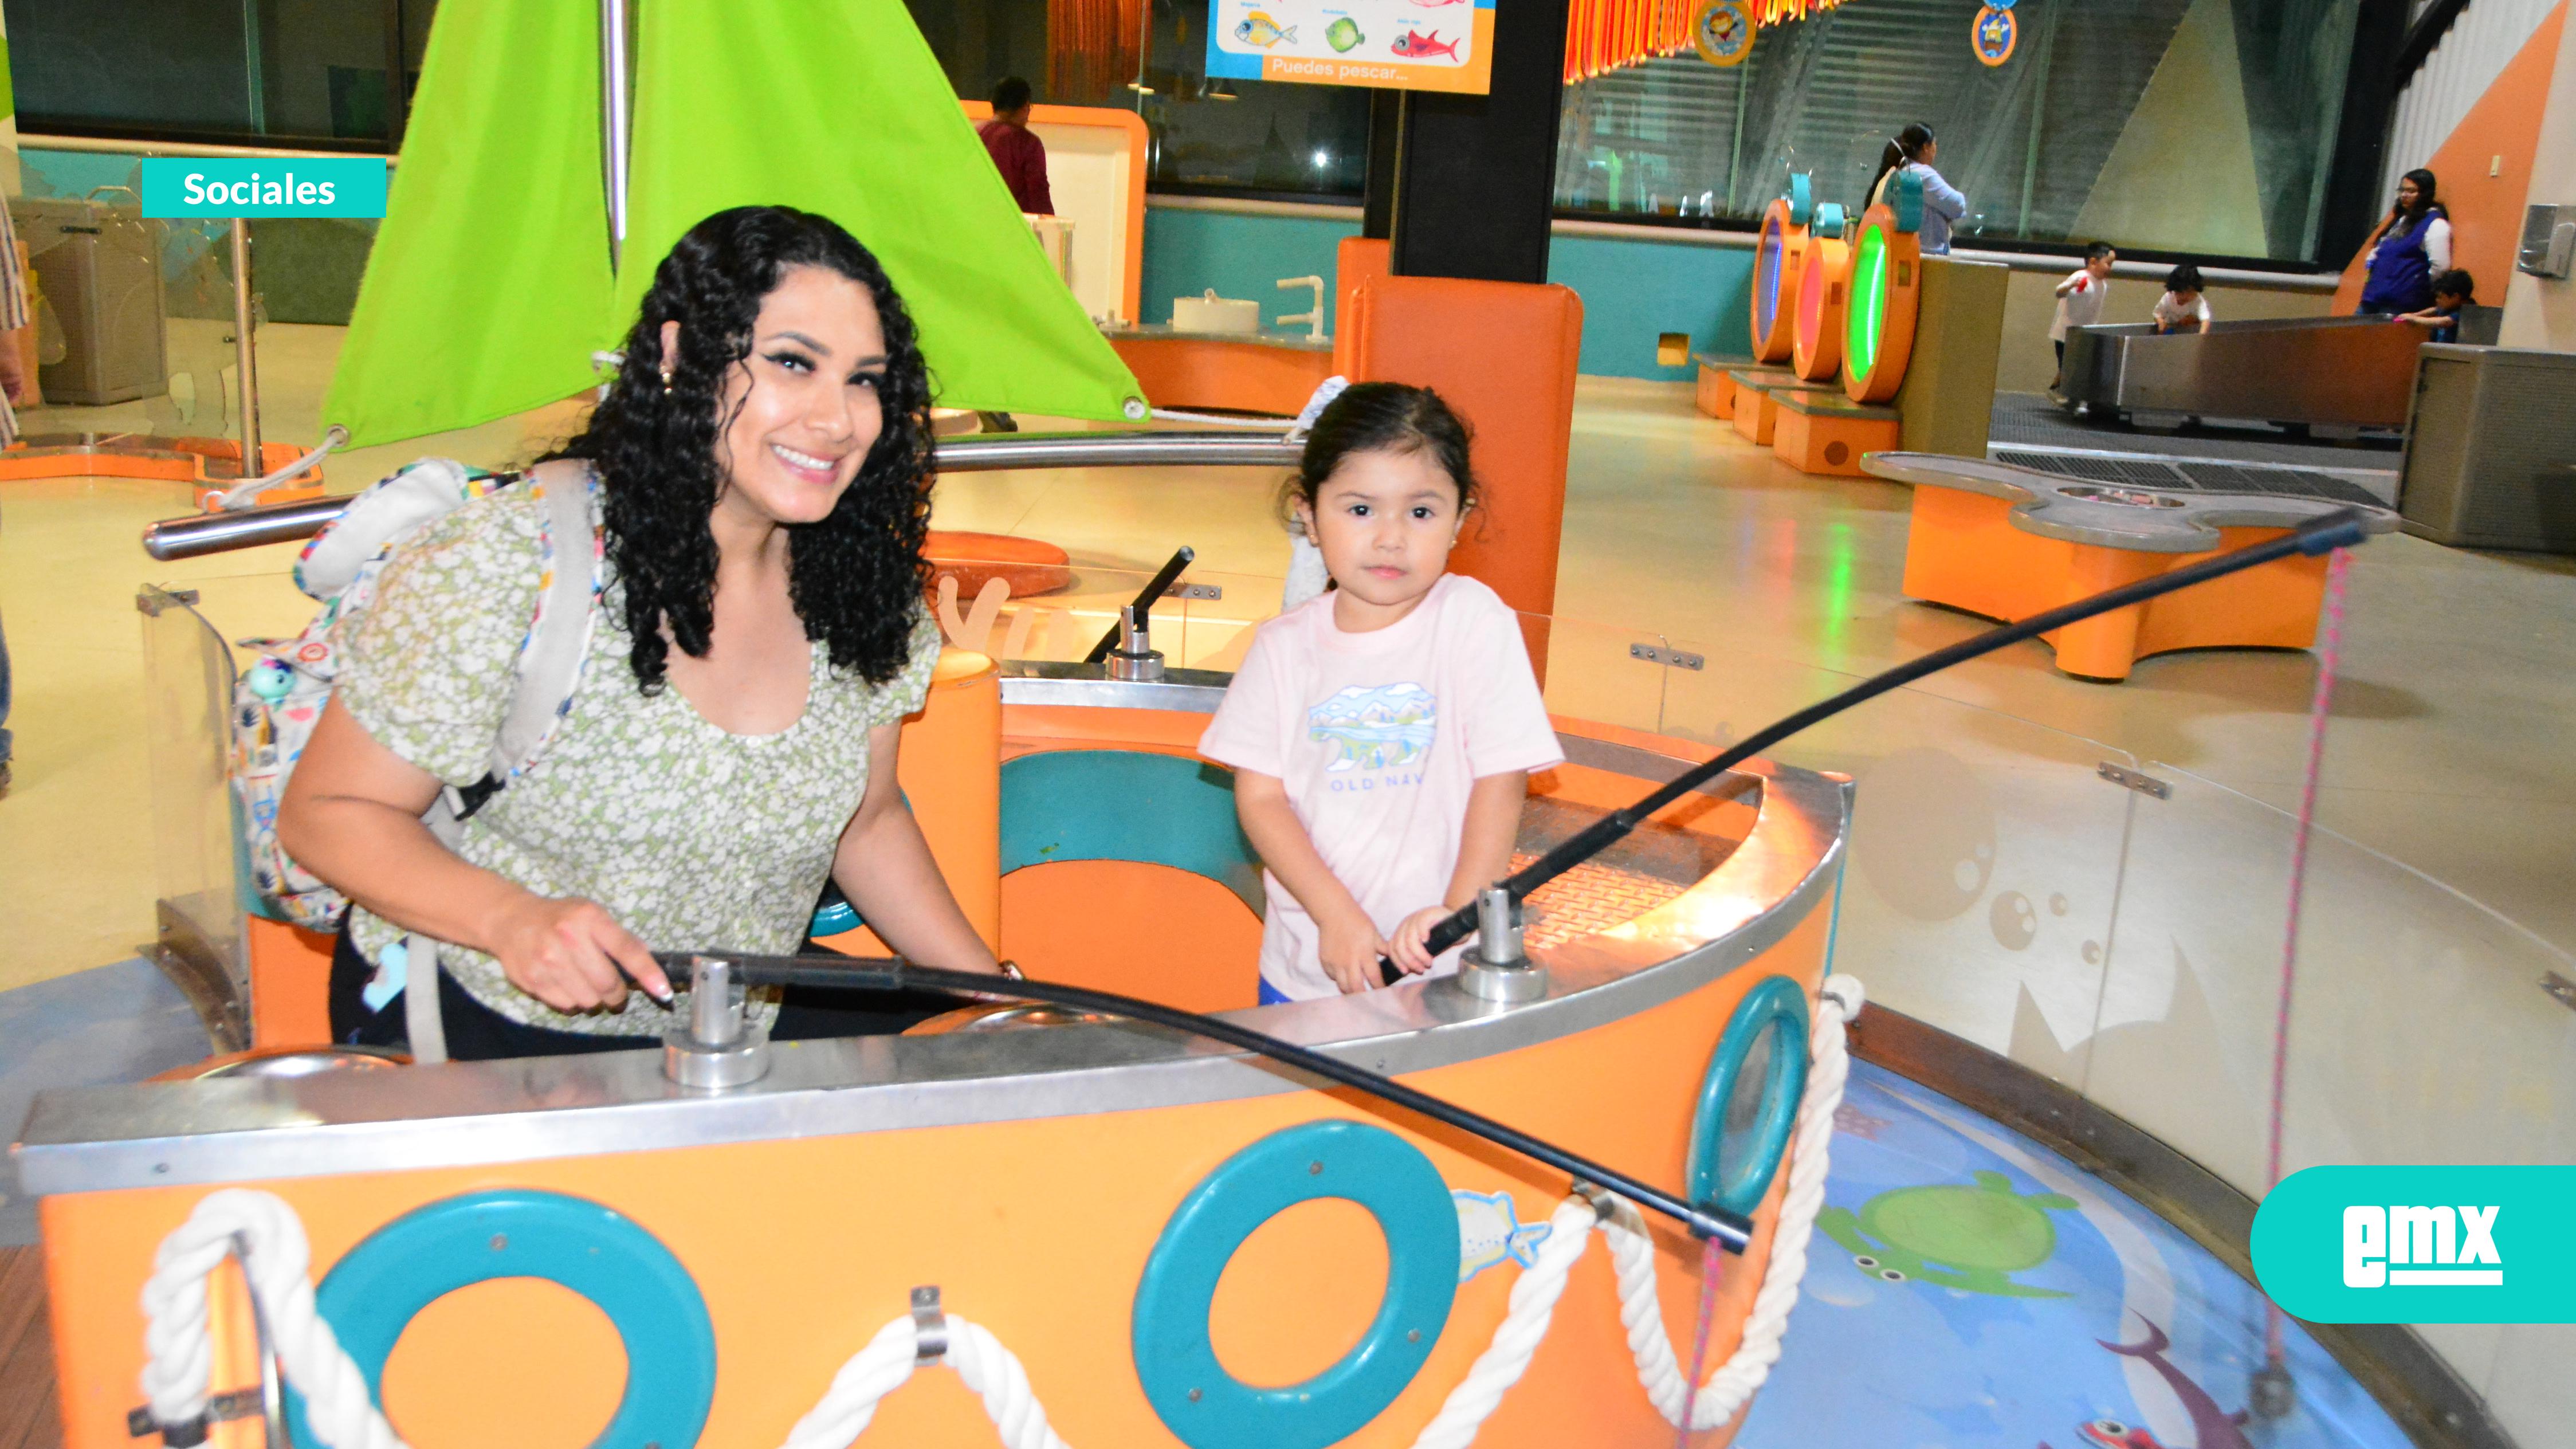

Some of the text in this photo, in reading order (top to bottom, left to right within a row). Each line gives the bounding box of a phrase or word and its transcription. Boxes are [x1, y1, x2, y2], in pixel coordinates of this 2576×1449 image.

[1272, 58, 1408, 80] Puedes pescar...
[1330, 772, 1423, 792] OLD NAV
